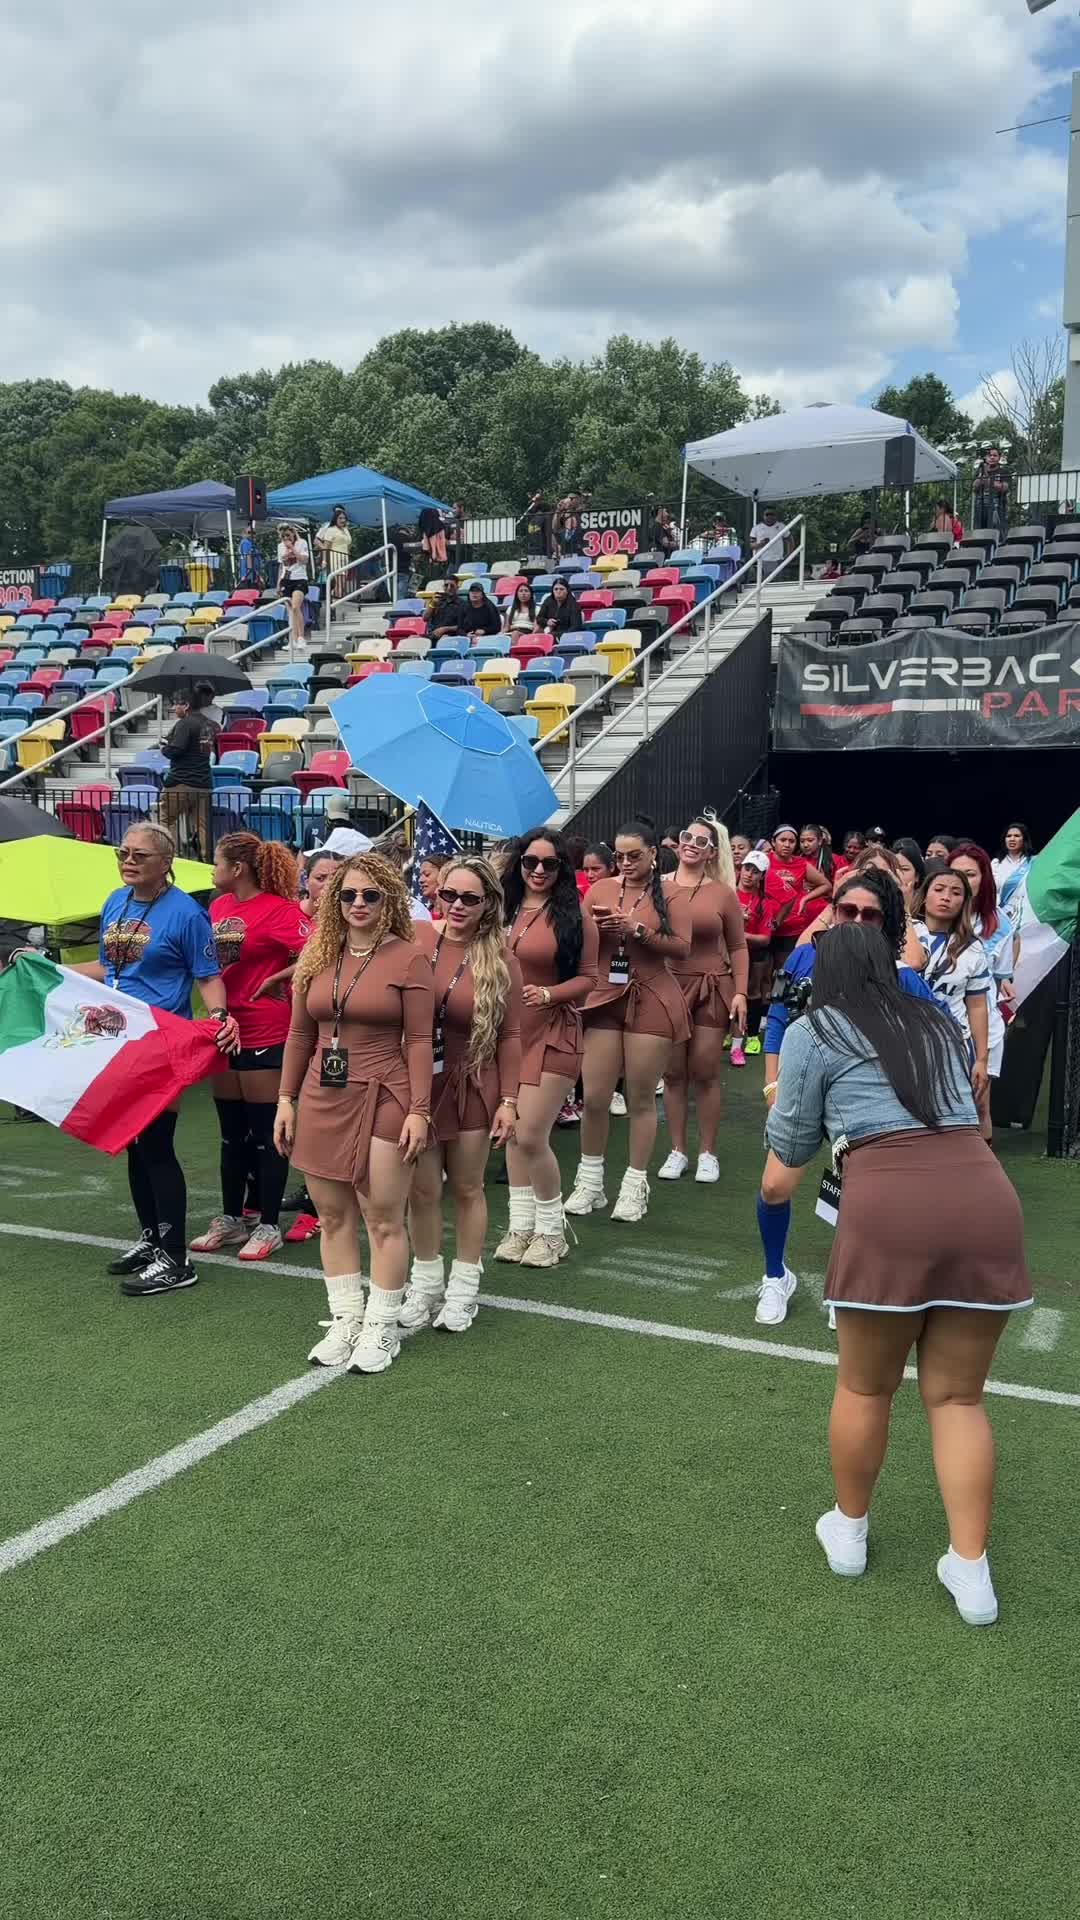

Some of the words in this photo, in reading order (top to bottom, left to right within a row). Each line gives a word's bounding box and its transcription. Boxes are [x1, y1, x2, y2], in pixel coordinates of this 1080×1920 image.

[580, 509, 641, 529] SECTION
[582, 528, 638, 557] 304
[464, 817, 504, 832] NAUTICA
[611, 960, 629, 968] STAFF
[821, 1179, 842, 1198] STAFF
